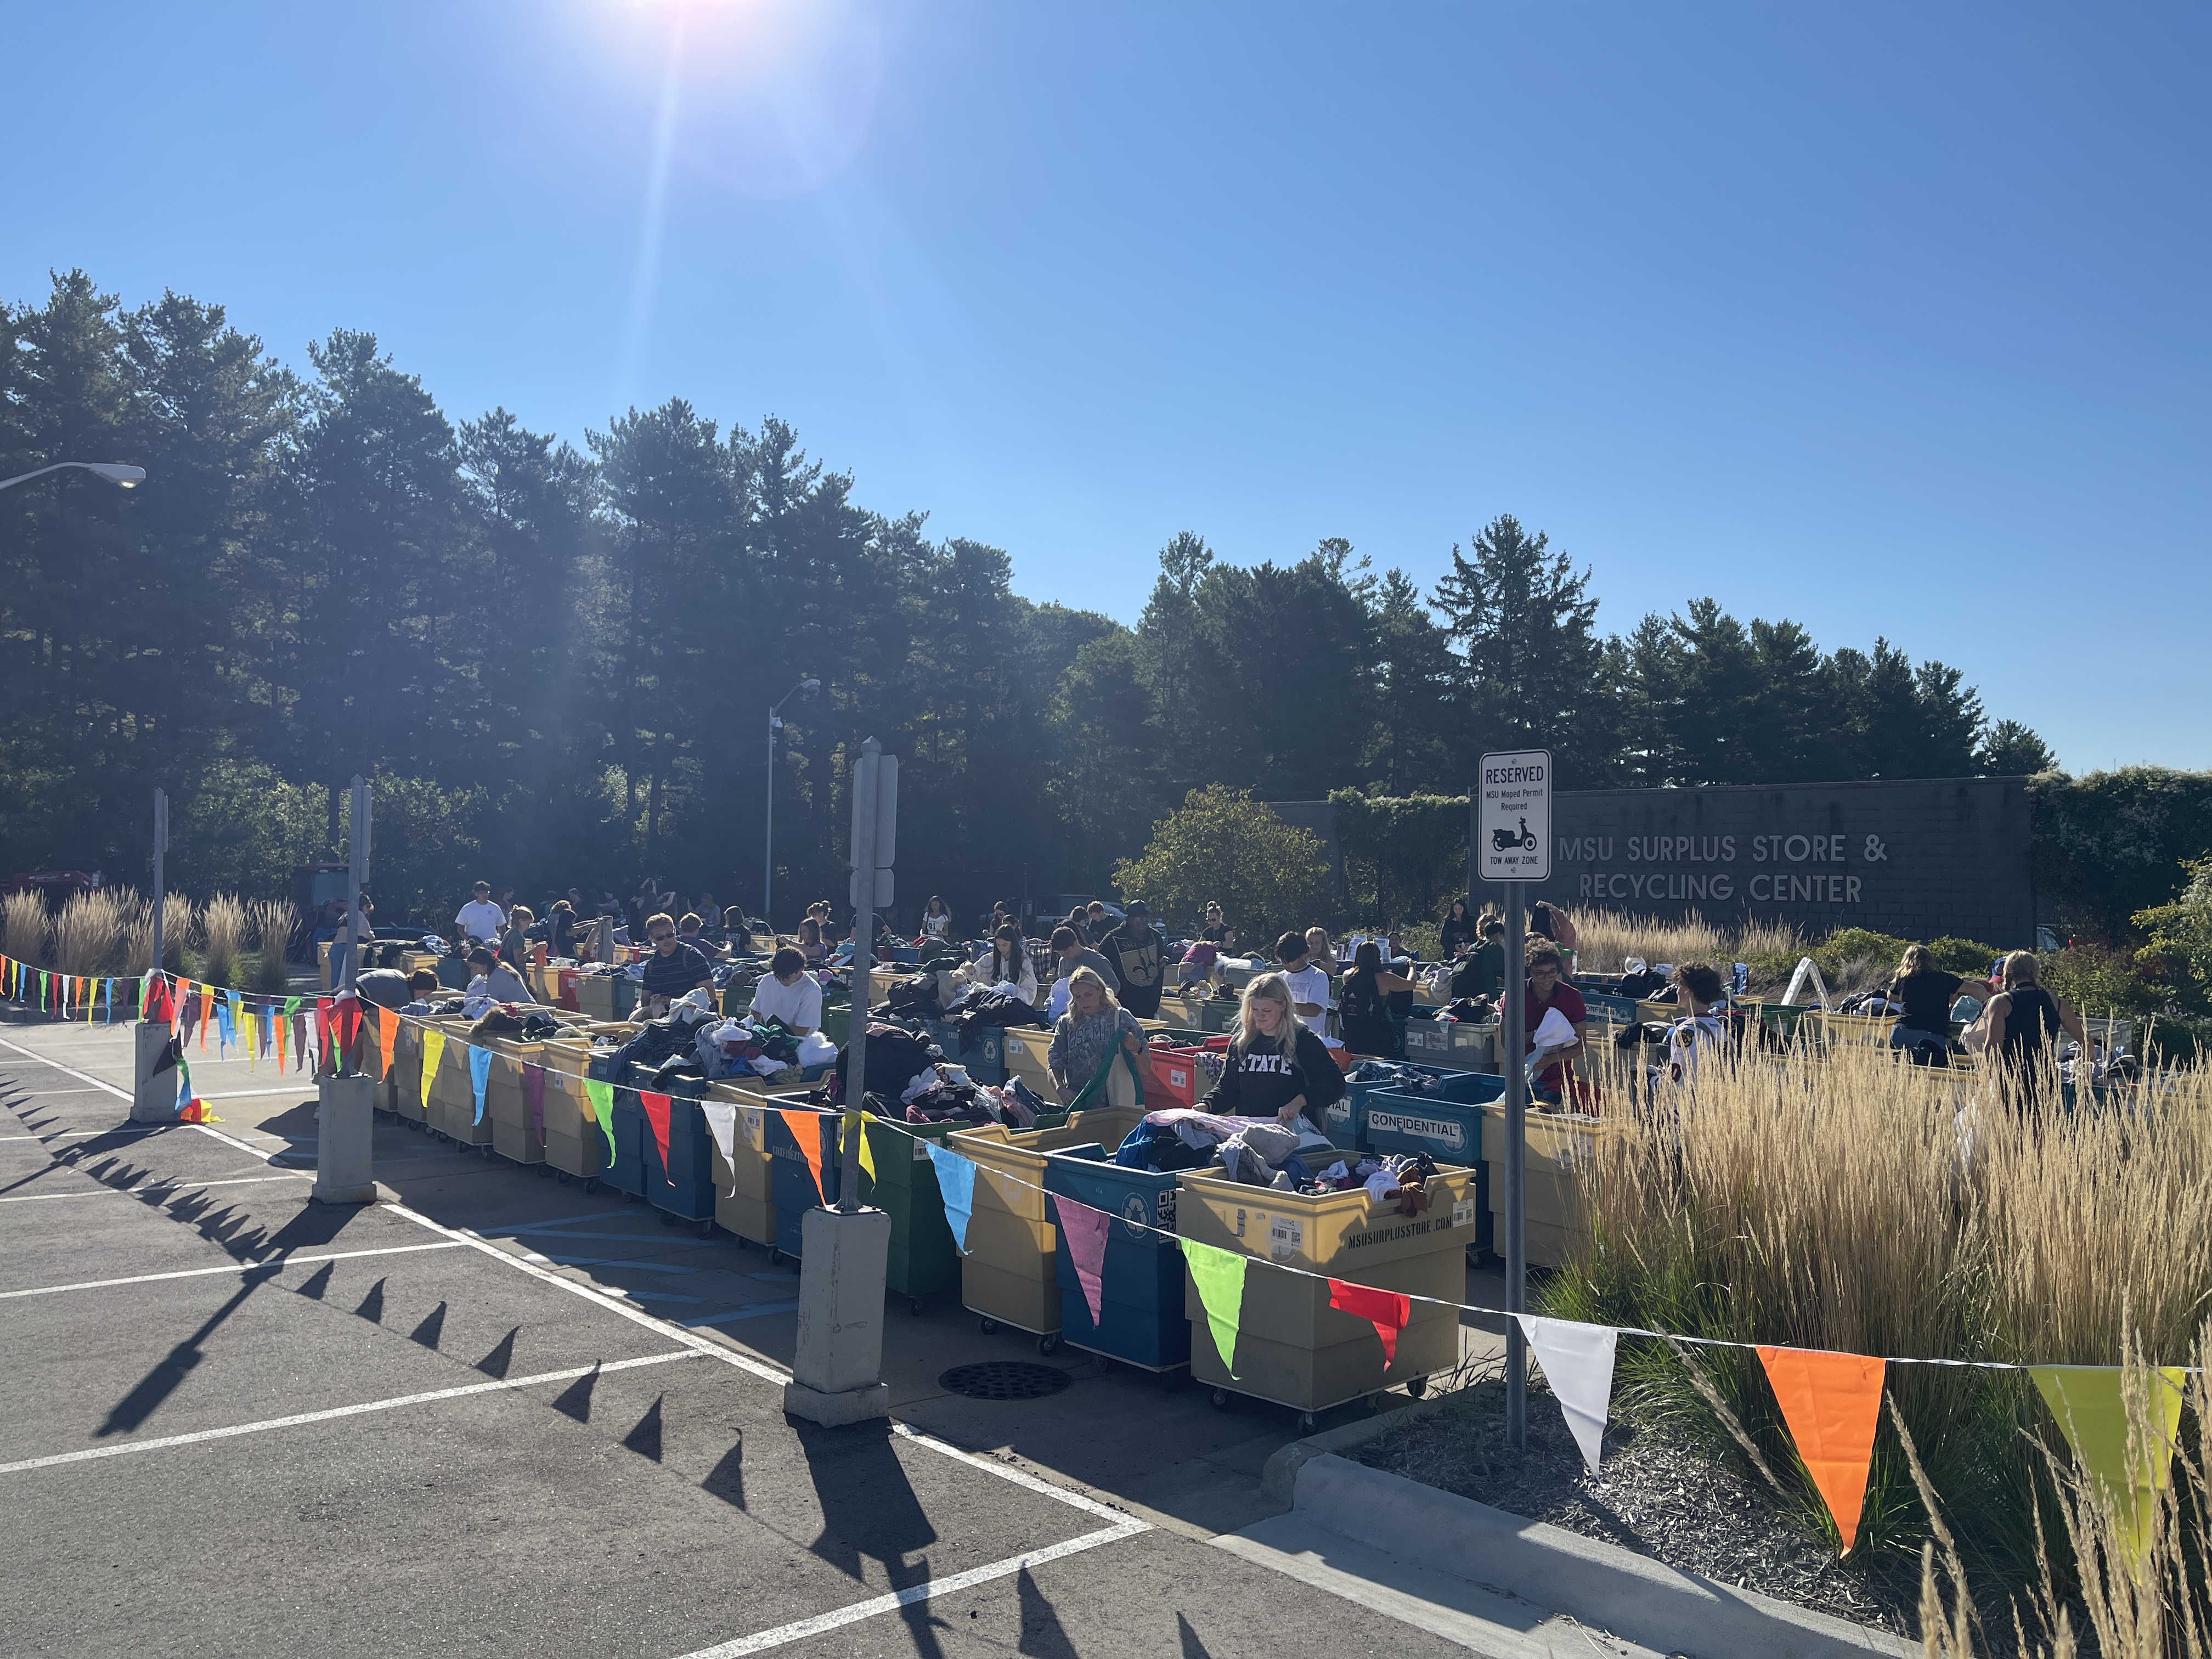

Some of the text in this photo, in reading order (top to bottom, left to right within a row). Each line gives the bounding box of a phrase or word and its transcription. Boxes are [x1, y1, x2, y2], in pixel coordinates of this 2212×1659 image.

[1486, 766, 1544, 785] RESERVED
[1486, 788, 1543, 799] MSU Moped Permit
[1501, 802, 1527, 812] Required
[1559, 834, 1888, 862] MSU SURPLUS STORE &
[1490, 856, 1538, 865] TOW AWAY ZONE
[1579, 873, 1862, 902] RECYCLING CENTER
[1238, 1053, 1293, 1076] STATE
[1372, 1113, 1457, 1137] CONFIDENTIAL
